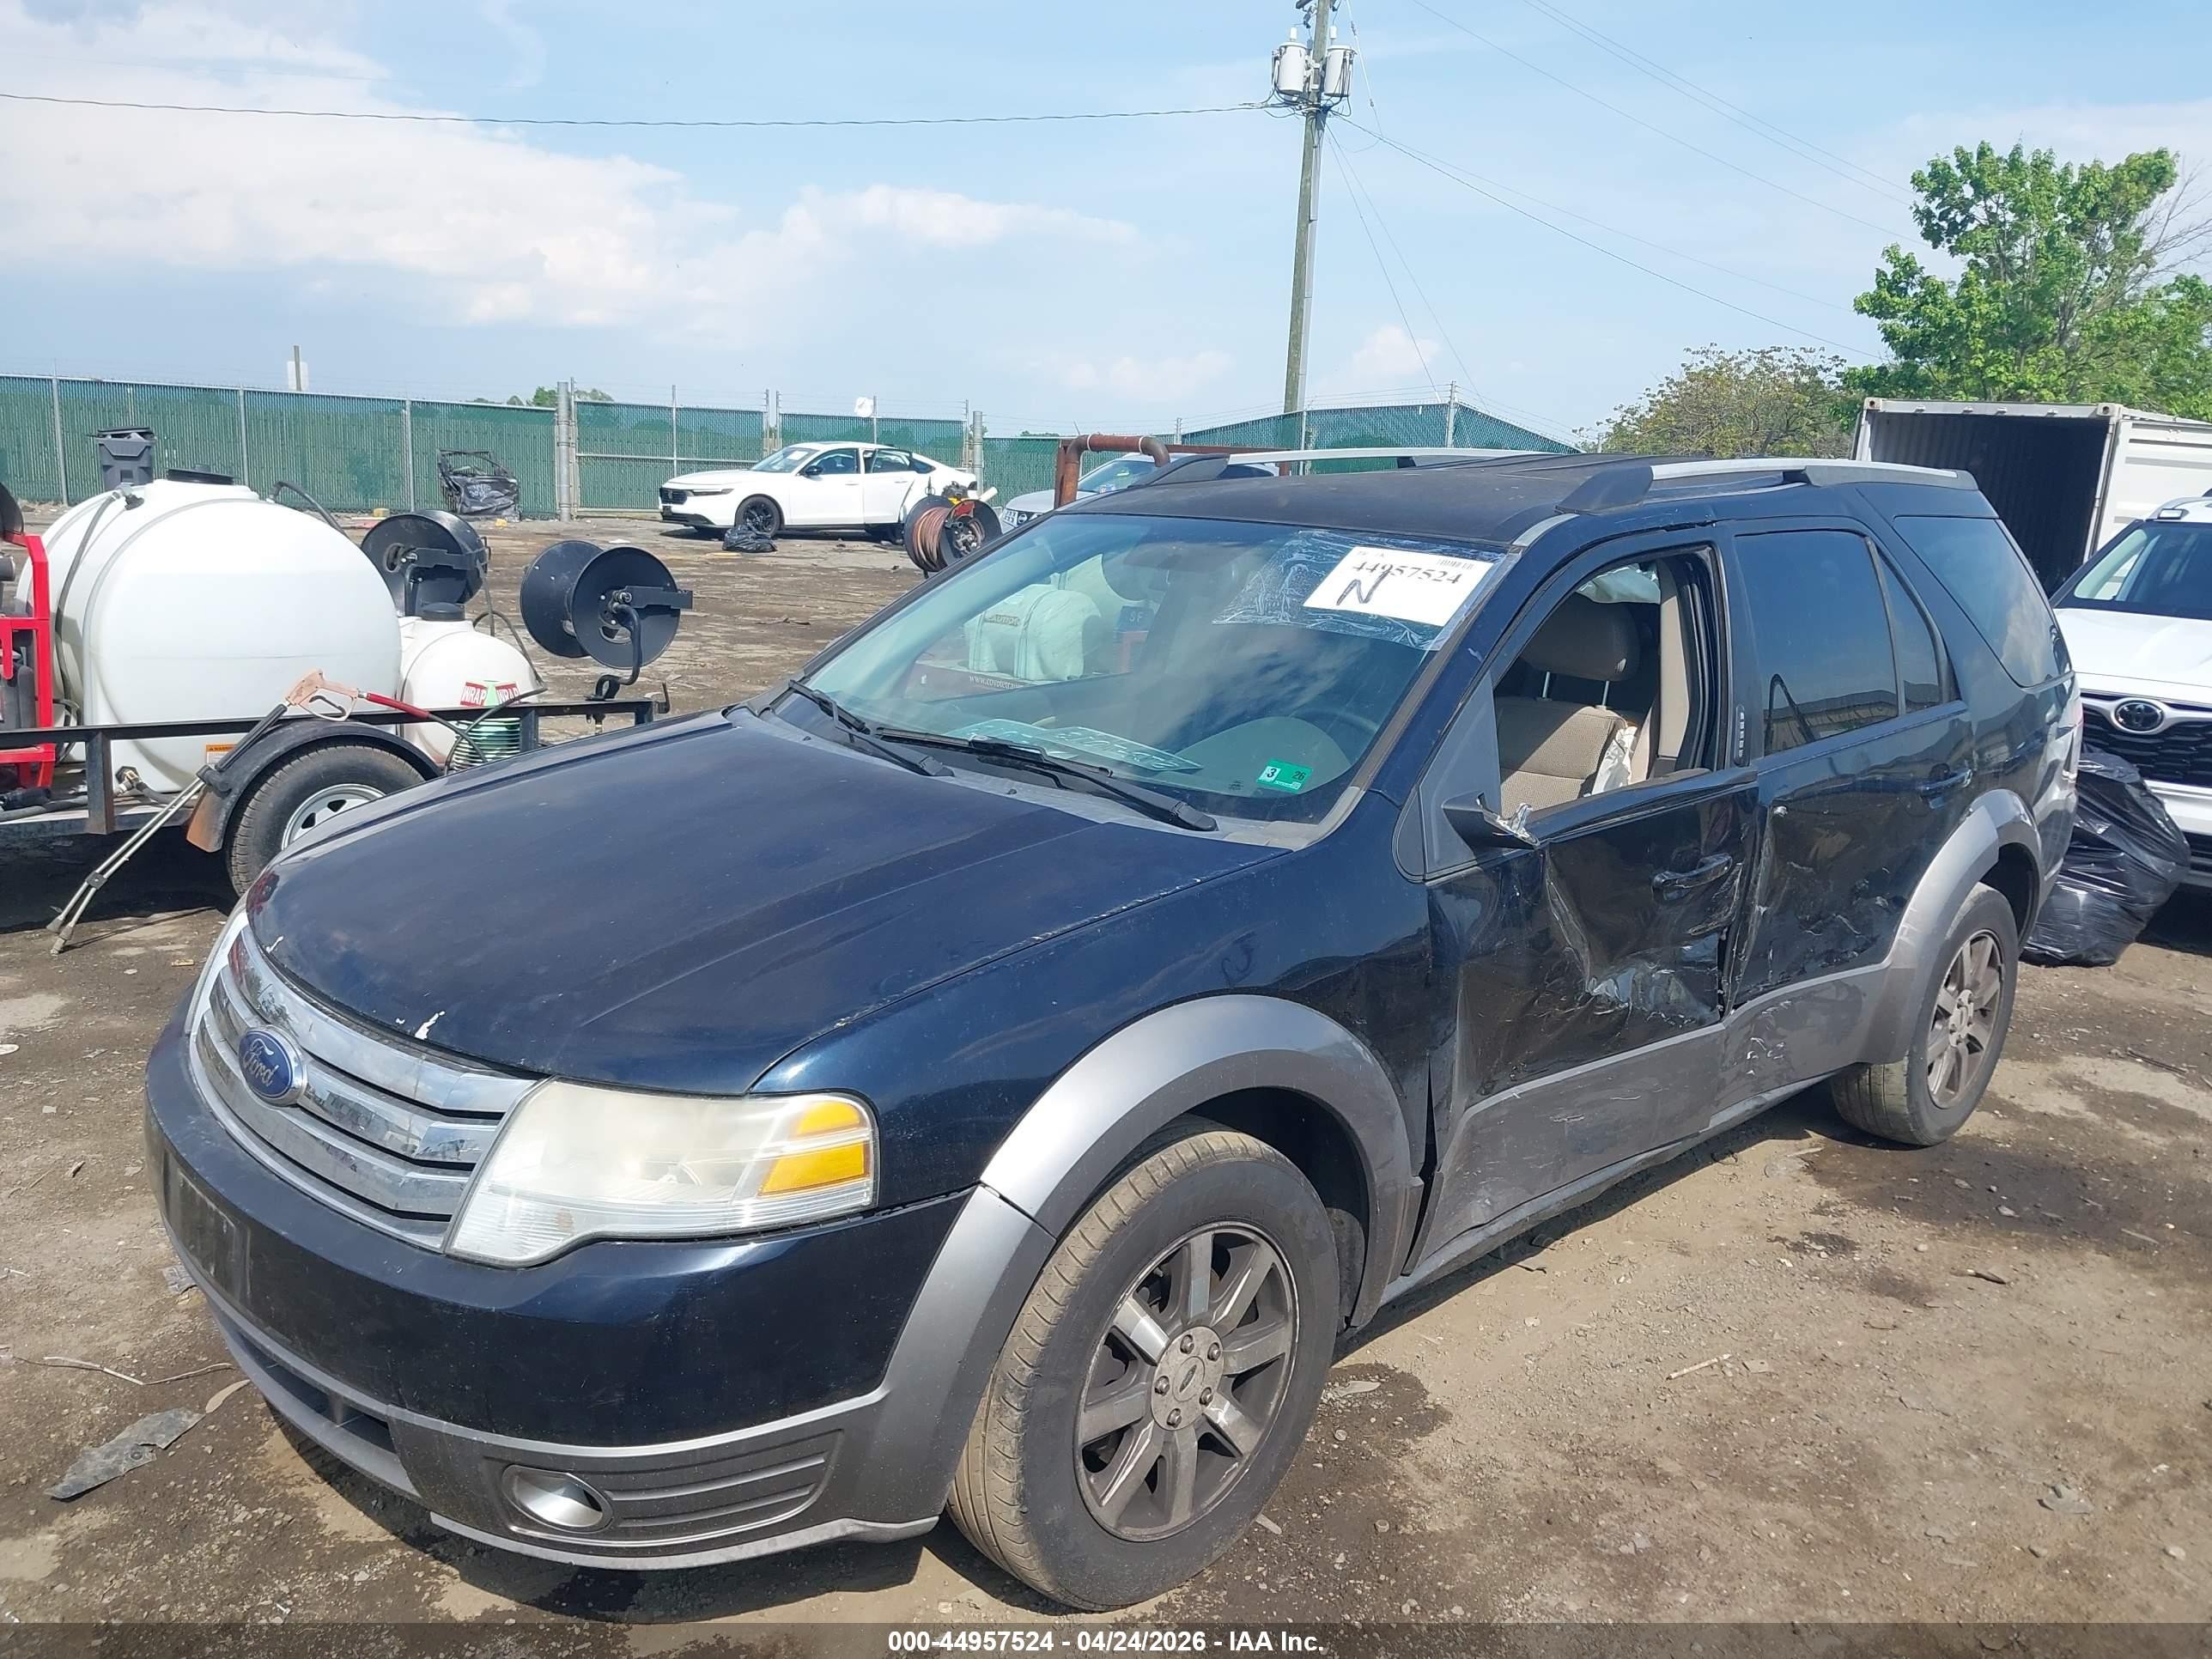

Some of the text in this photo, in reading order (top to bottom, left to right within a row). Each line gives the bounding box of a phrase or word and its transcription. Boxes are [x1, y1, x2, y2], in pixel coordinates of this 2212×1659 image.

[1352, 561, 1462, 584] 44957524
[461, 686, 487, 704] WRAP
[1267, 768, 1278, 778] 3
[1291, 770, 1306, 781] 26
[242, 1038, 280, 1087] Ford
